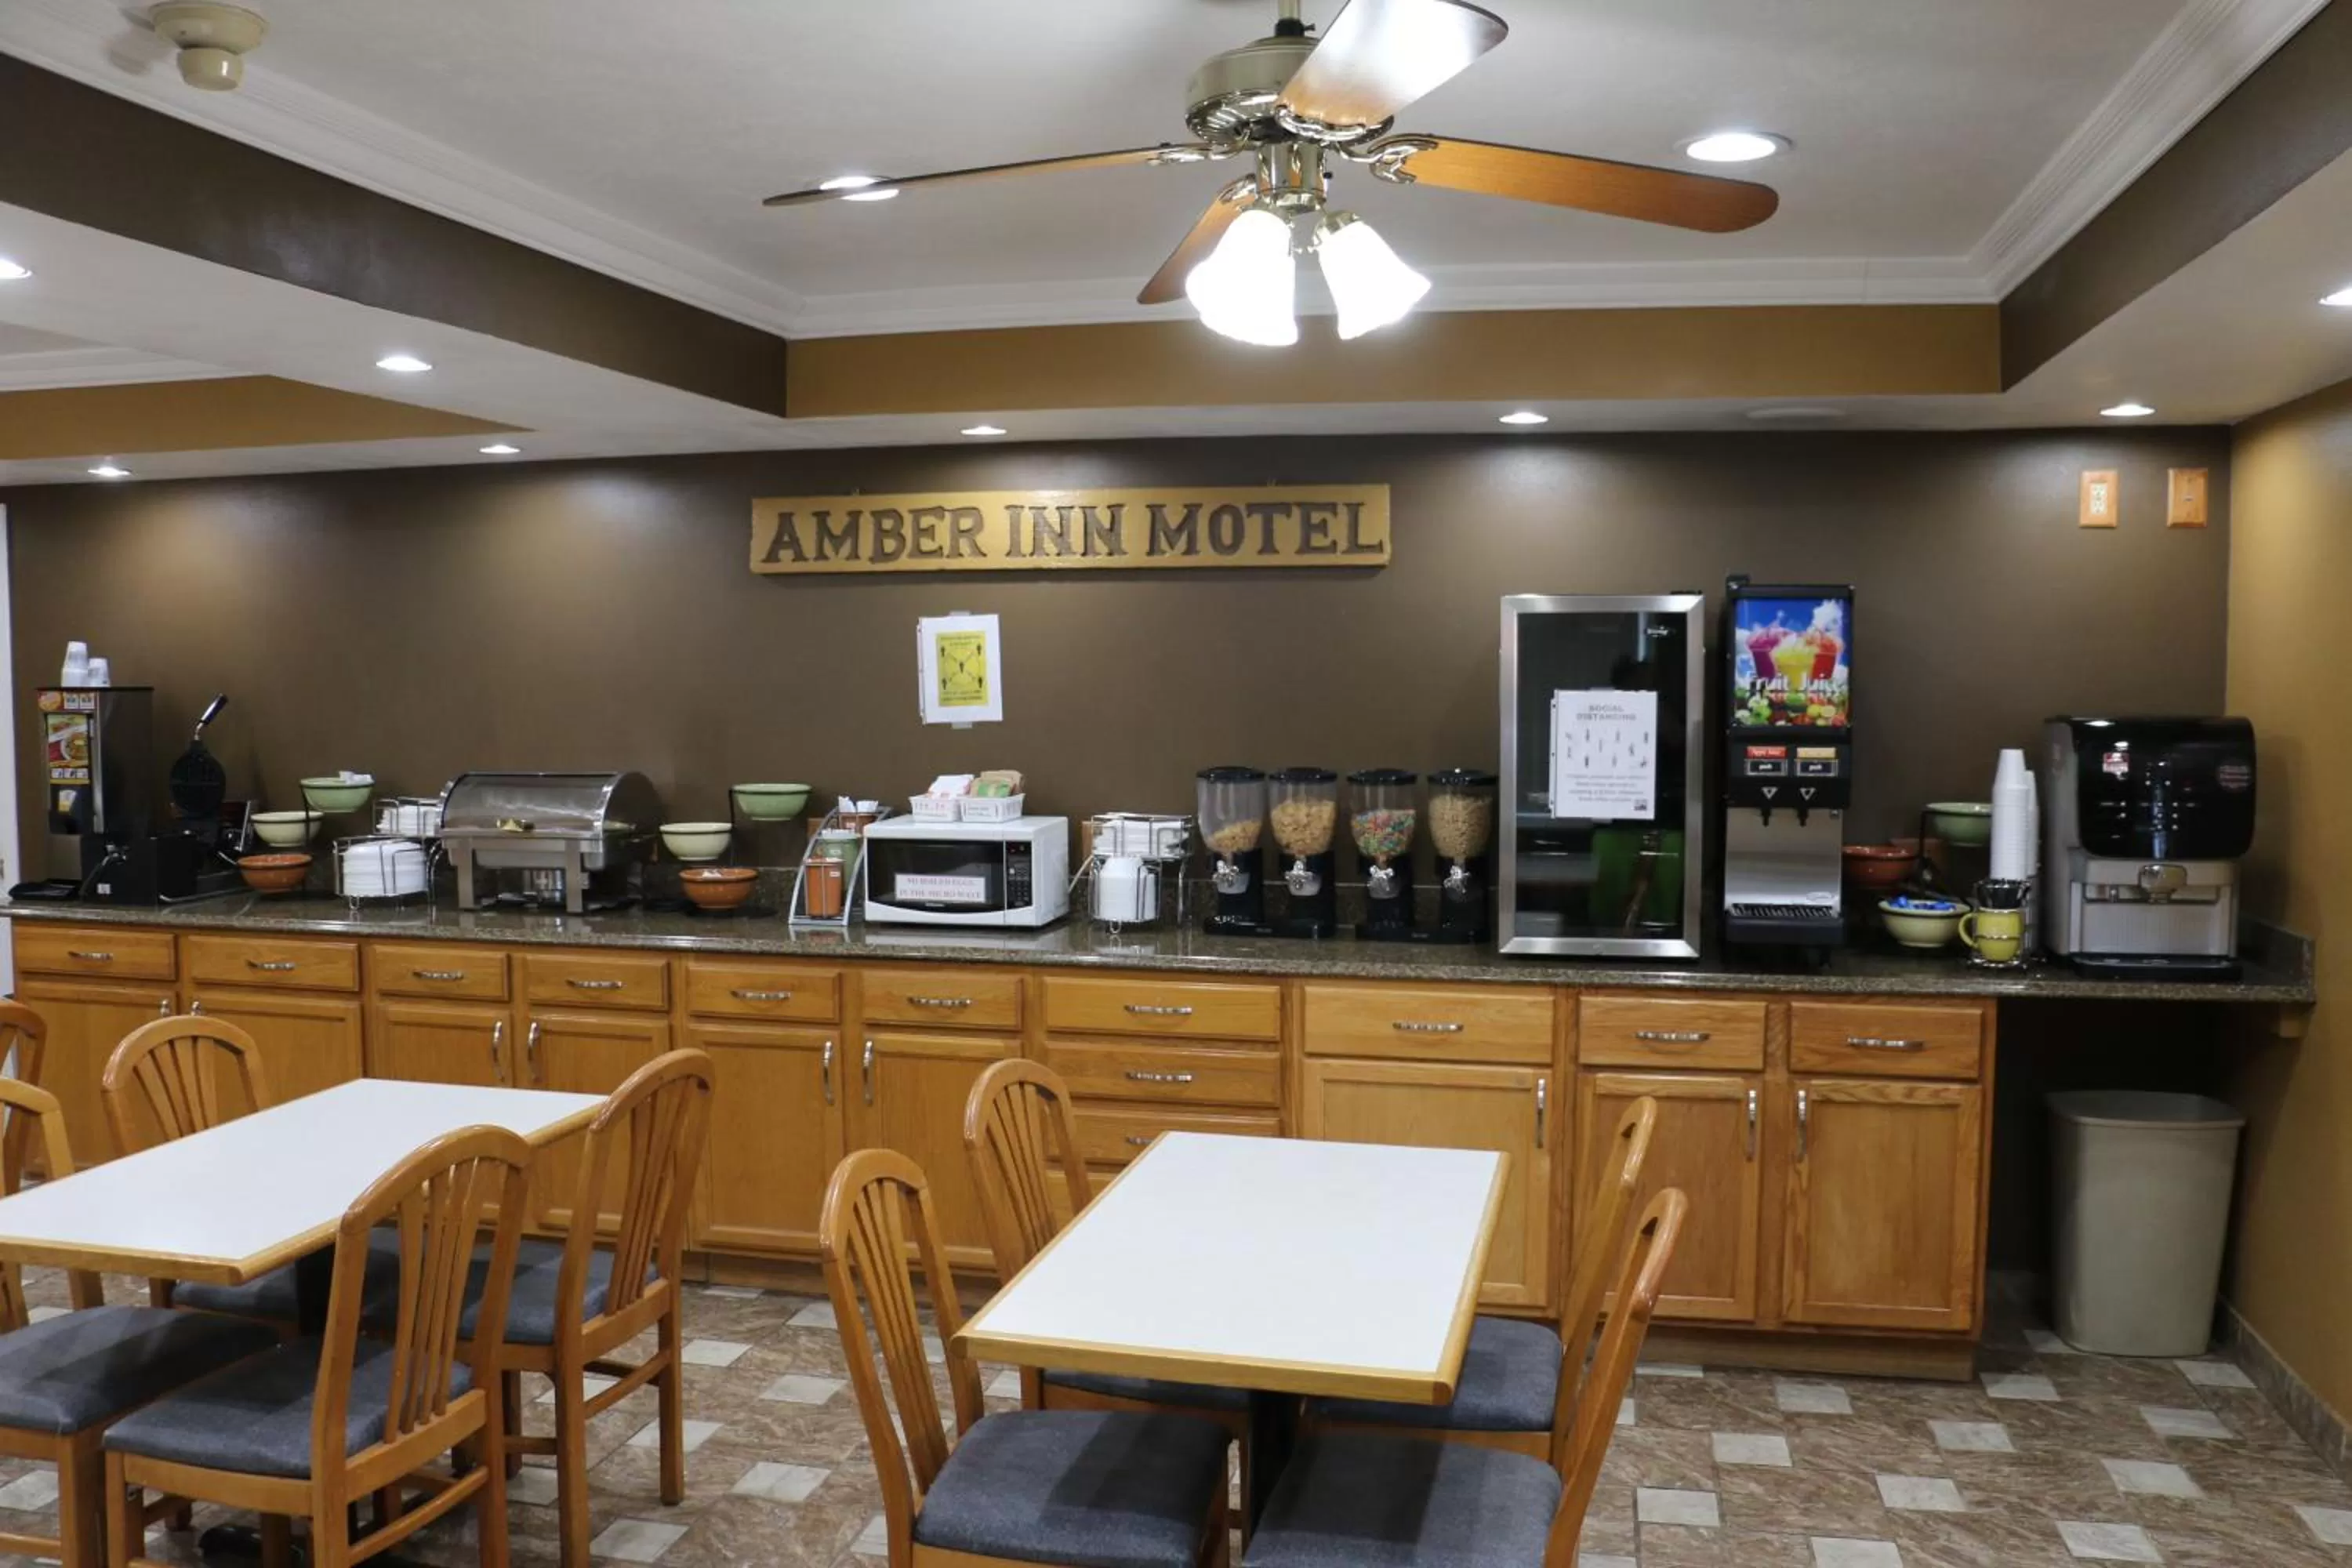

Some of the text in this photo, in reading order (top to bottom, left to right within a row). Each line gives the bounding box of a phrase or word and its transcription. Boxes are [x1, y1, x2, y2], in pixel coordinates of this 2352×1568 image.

[760, 502, 1384, 564] AMBER INN MOTEL
[1748, 672, 1849, 691] Fruit Juice
